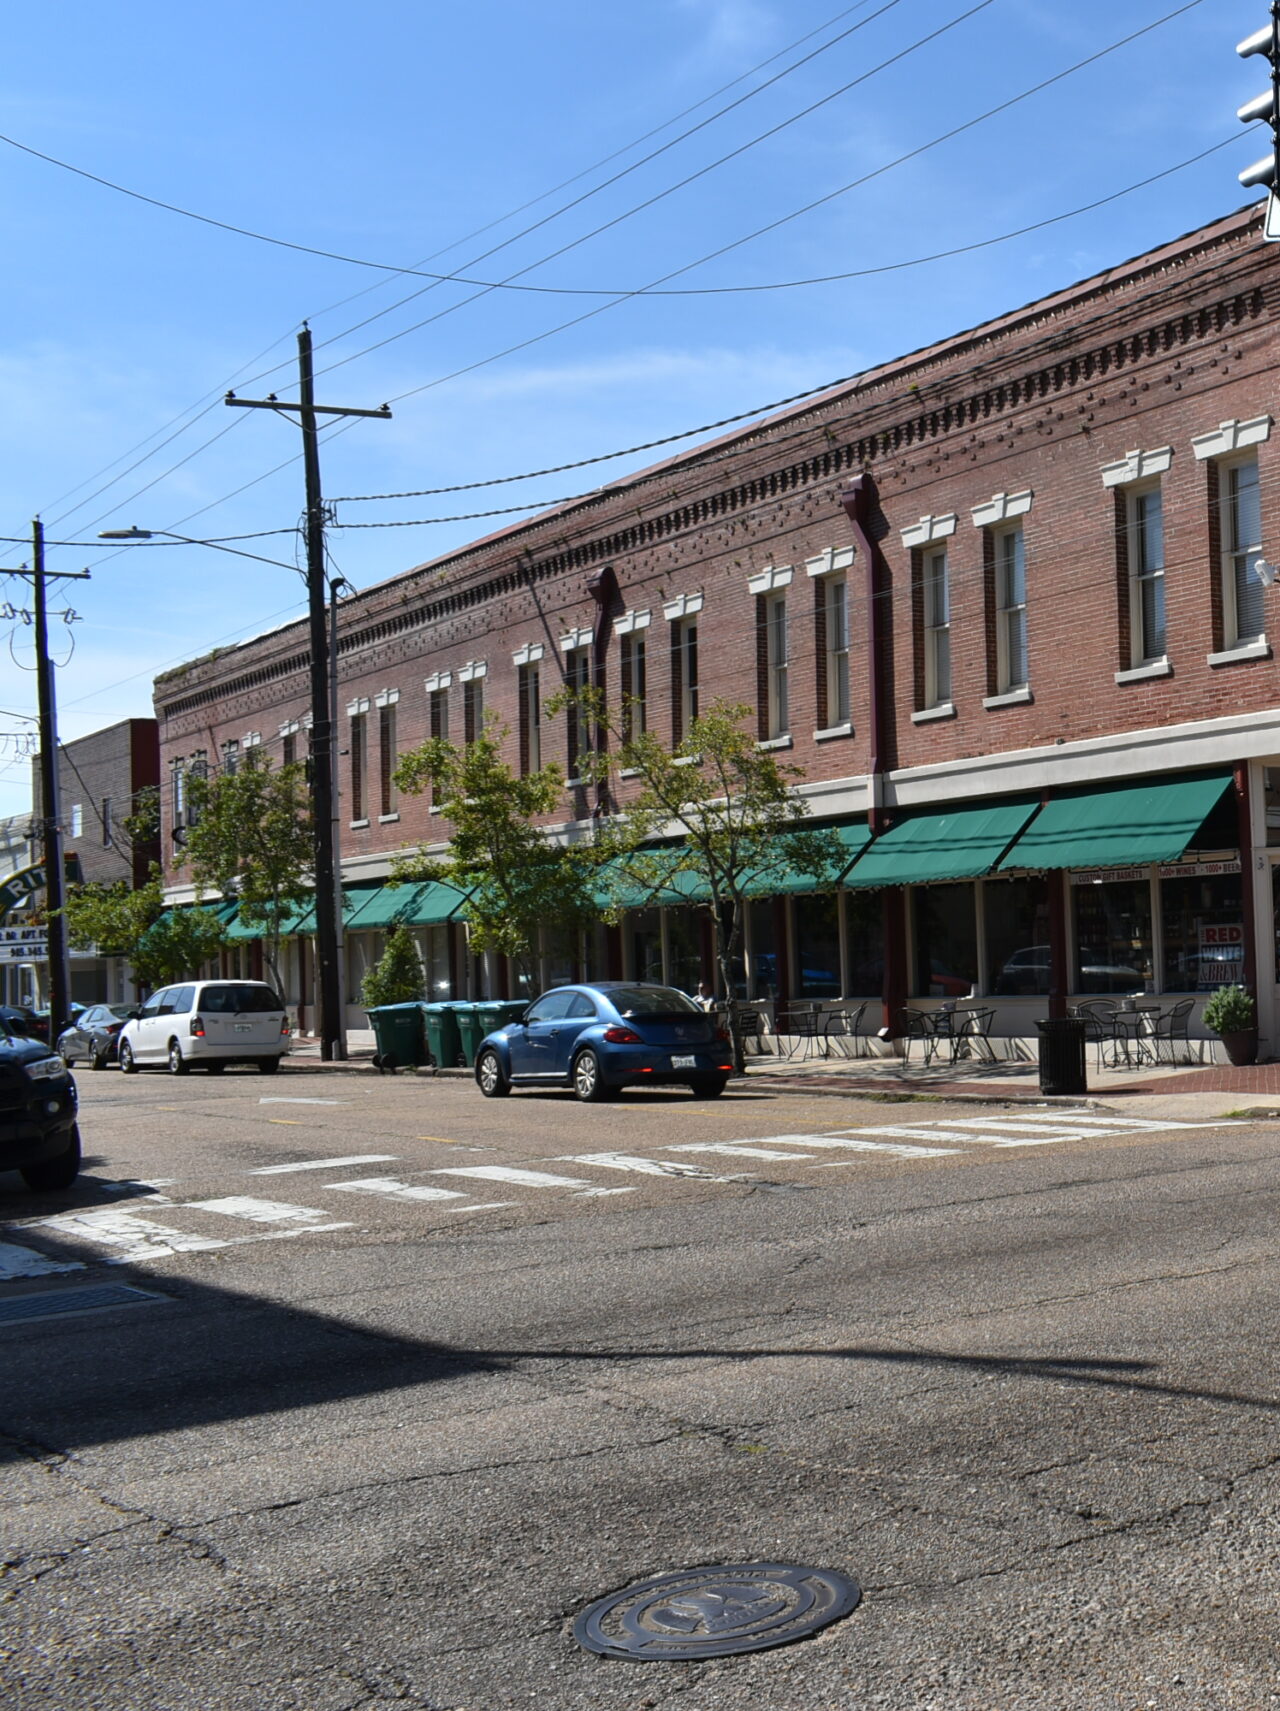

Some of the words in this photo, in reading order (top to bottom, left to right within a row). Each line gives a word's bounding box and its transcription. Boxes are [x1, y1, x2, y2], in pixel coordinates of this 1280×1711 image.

[1102, 871, 1115, 881] GIFT
[1116, 870, 1143, 880] BASKETS
[1205, 926, 1241, 942] RED
